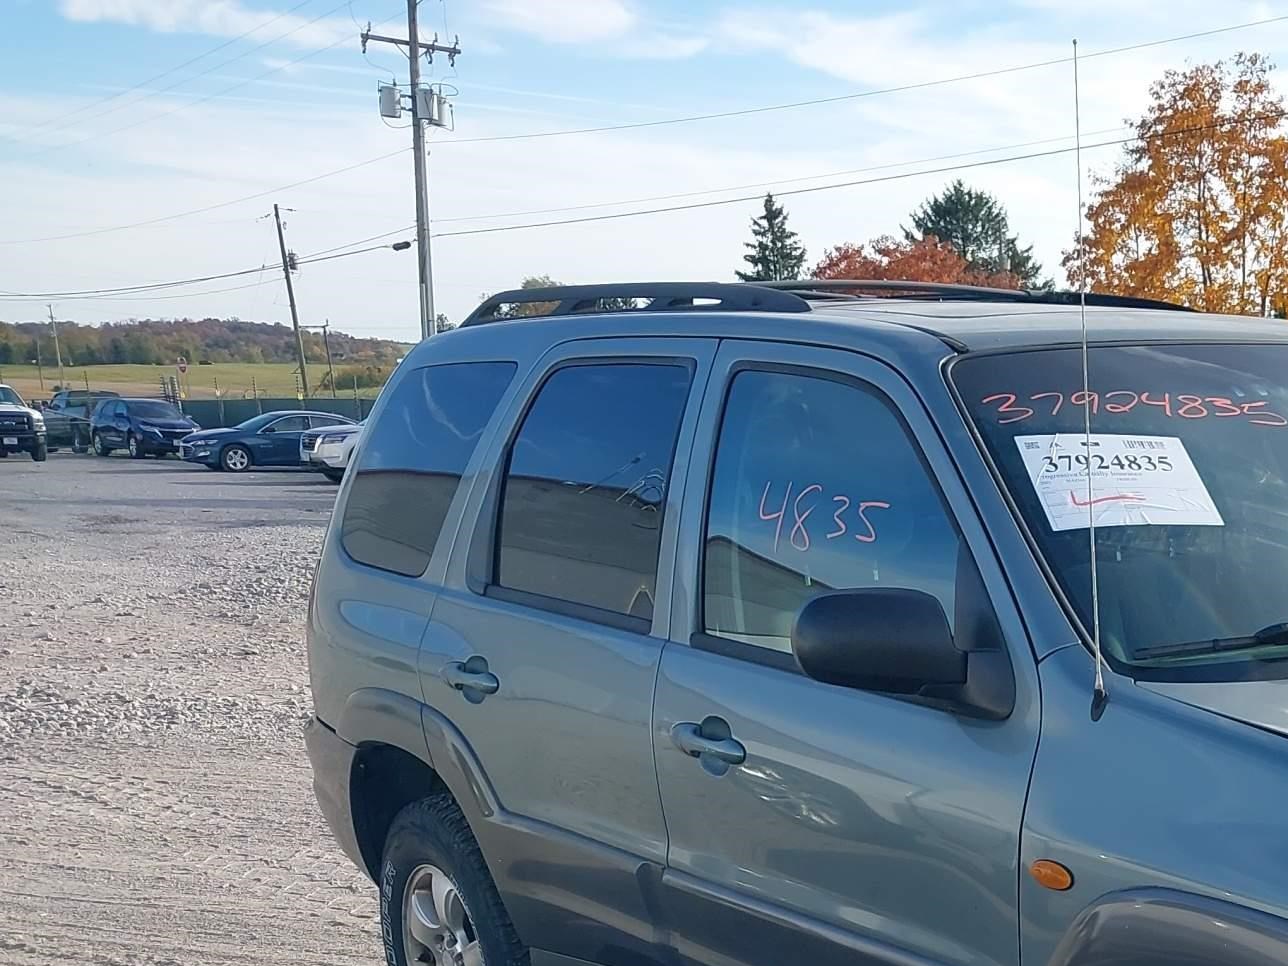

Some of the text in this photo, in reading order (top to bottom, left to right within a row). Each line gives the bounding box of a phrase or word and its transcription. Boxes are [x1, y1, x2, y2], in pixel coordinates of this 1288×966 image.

[982, 391, 1288, 426] 37924835
[1041, 454, 1173, 472] 37924835
[758, 480, 891, 554] 4835
